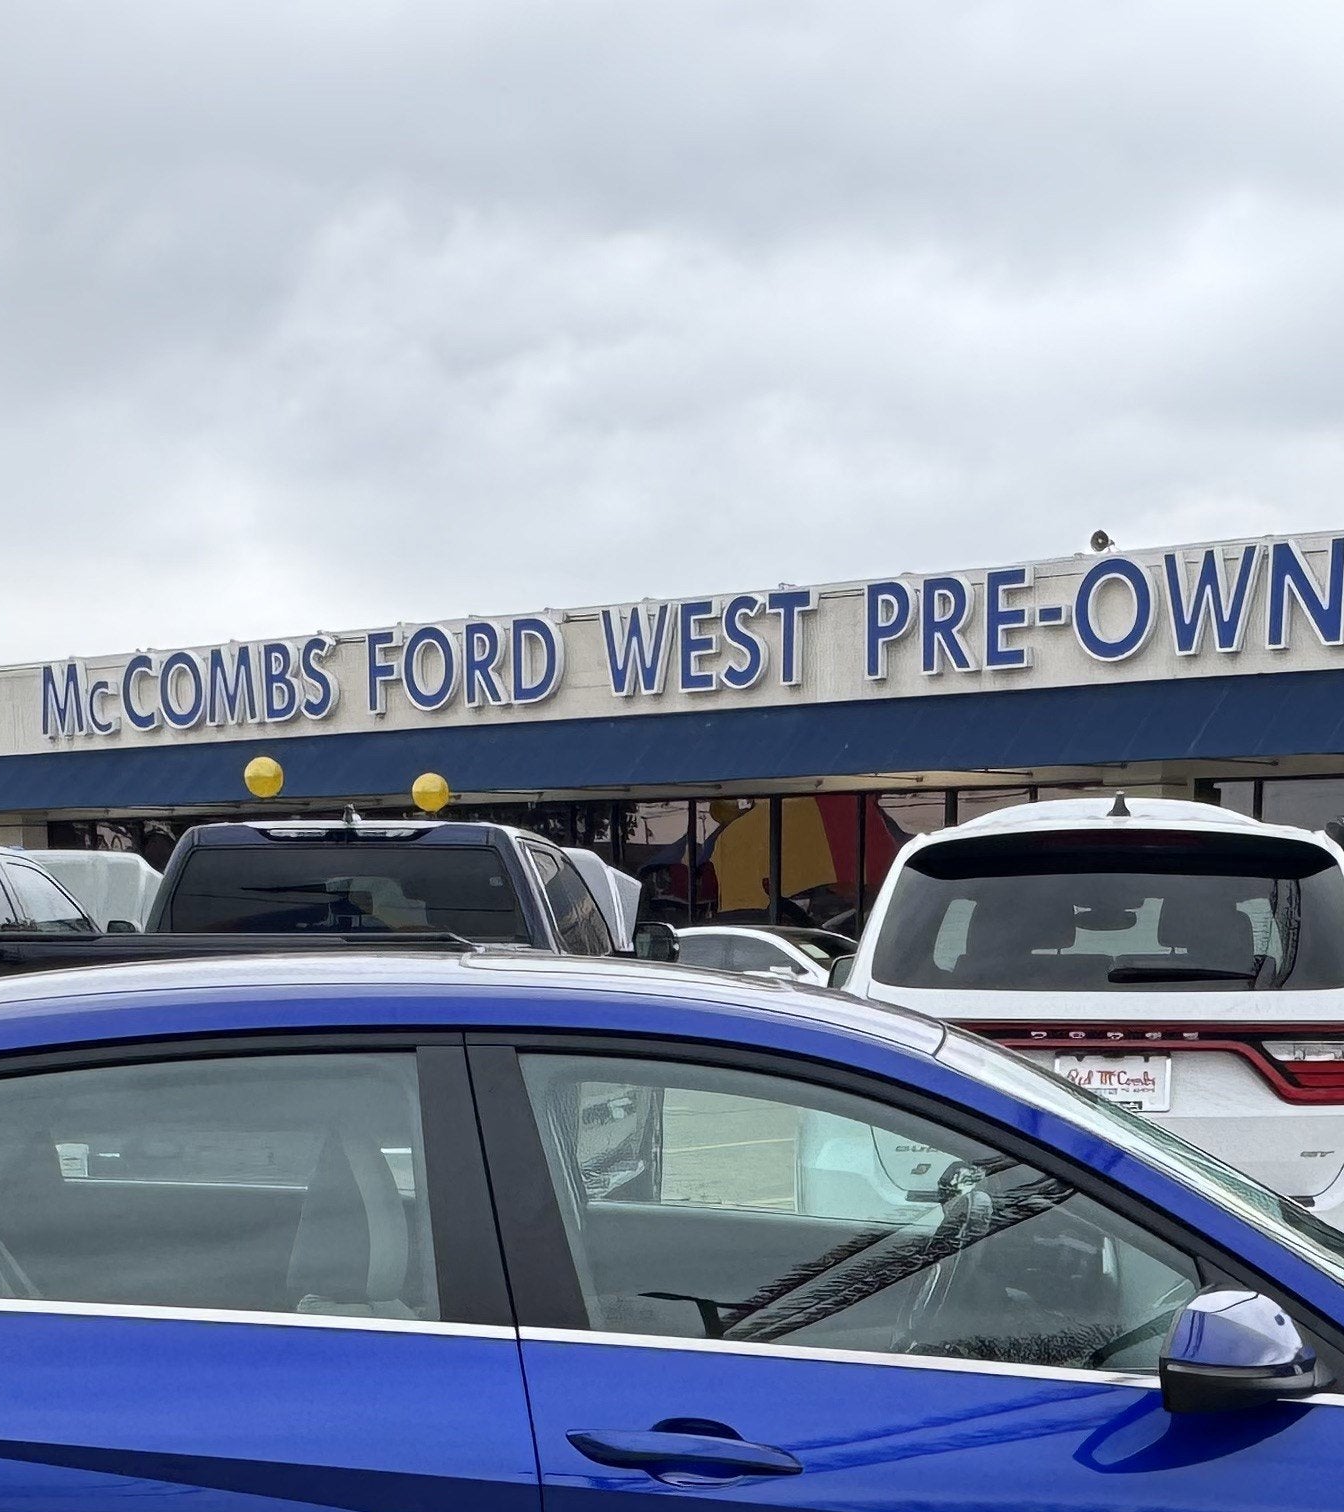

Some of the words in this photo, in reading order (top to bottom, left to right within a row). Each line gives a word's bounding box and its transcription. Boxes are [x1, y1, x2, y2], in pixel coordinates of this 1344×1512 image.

[41, 635, 339, 739] McCOMBS
[367, 612, 565, 715] FORD
[599, 588, 818, 697] WEST
